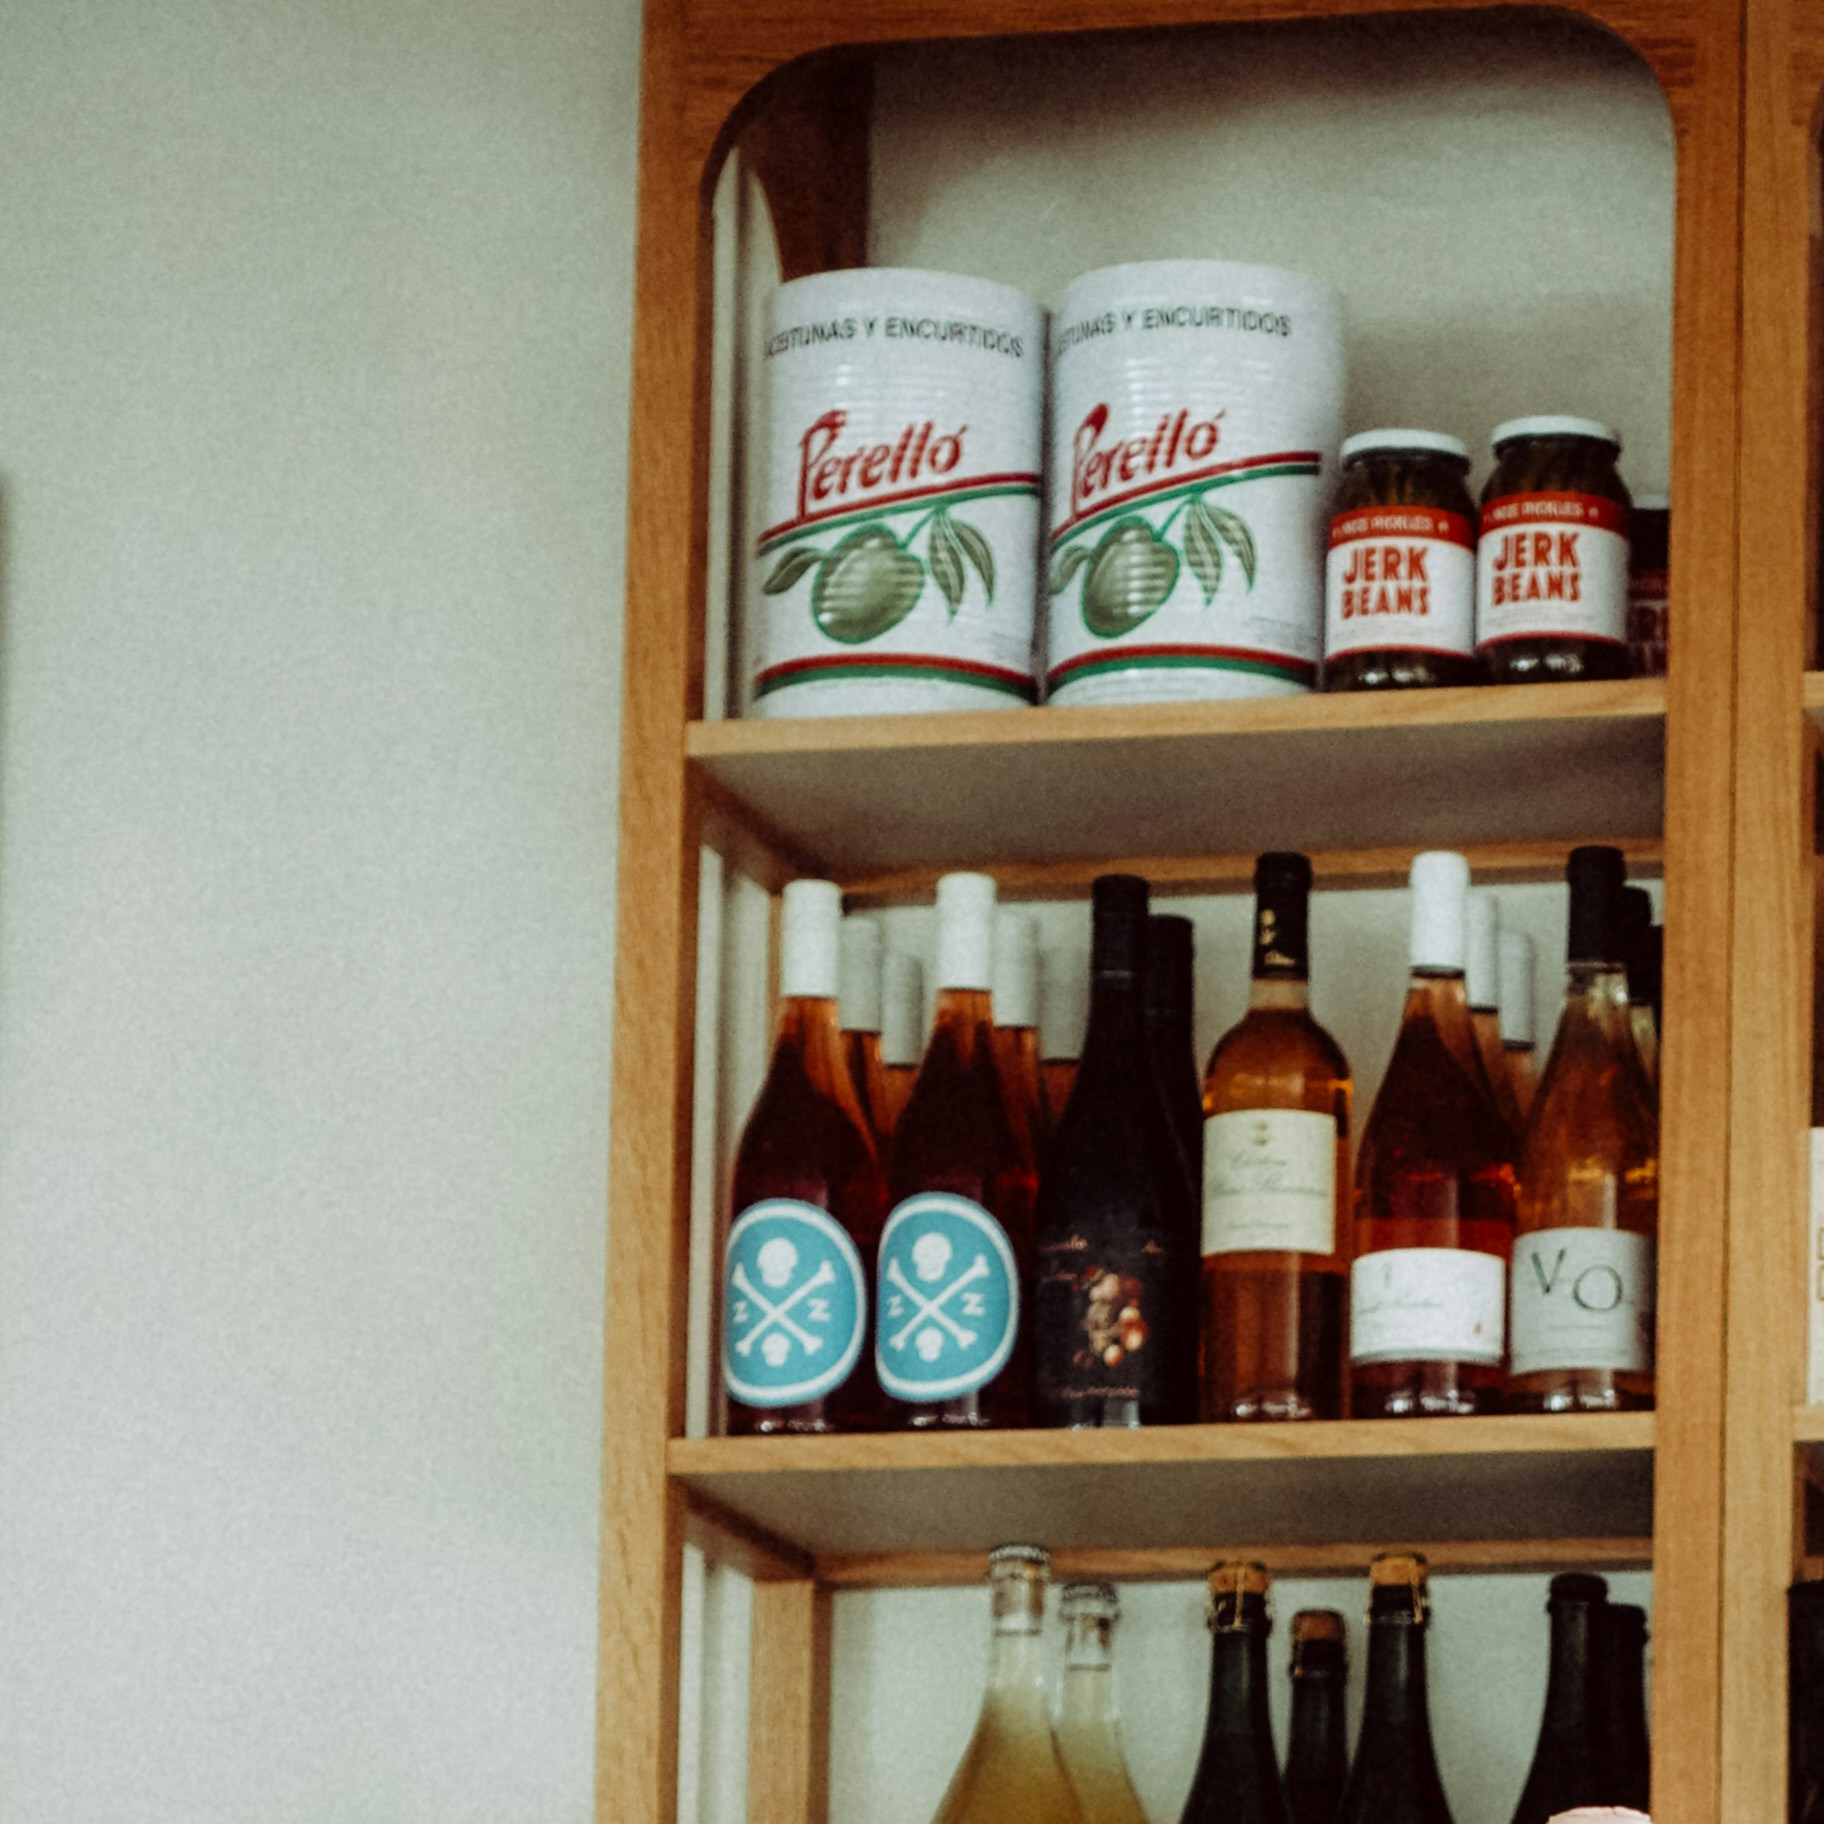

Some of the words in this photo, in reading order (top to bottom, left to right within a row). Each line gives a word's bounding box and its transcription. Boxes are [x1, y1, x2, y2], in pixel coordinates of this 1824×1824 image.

[1342, 545, 1430, 584] JERK
[1493, 531, 1580, 571] JERK
[1340, 584, 1430, 620] BEANS
[1493, 571, 1582, 606] BEANS
